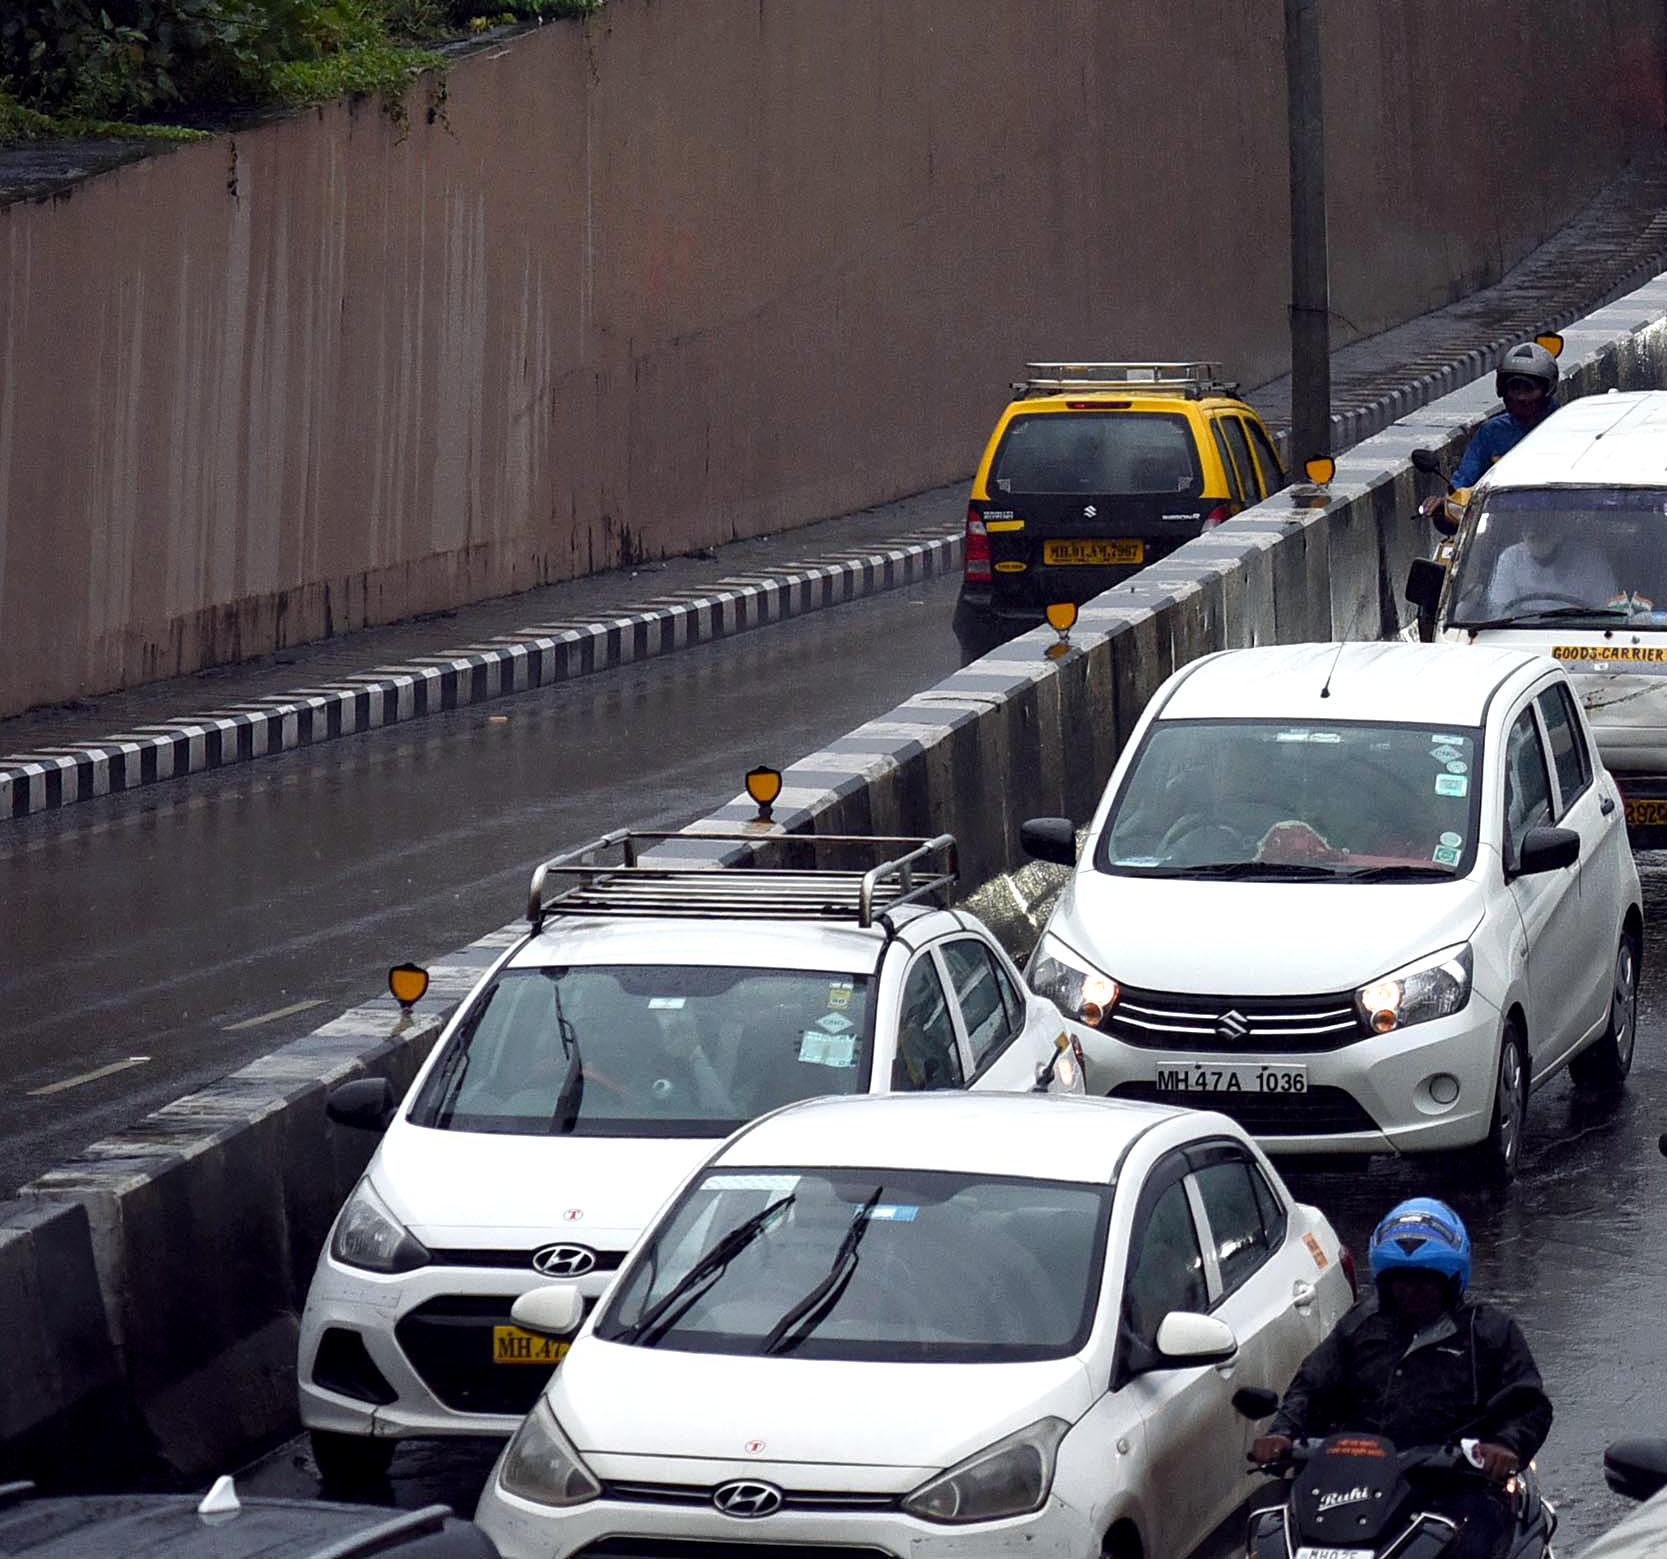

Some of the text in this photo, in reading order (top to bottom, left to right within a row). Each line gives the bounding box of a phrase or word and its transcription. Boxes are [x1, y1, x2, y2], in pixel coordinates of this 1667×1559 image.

[1157, 1068, 1190, 1091] MH
[1258, 1068, 1305, 1092] 1036
[498, 1336, 534, 1360] MH
